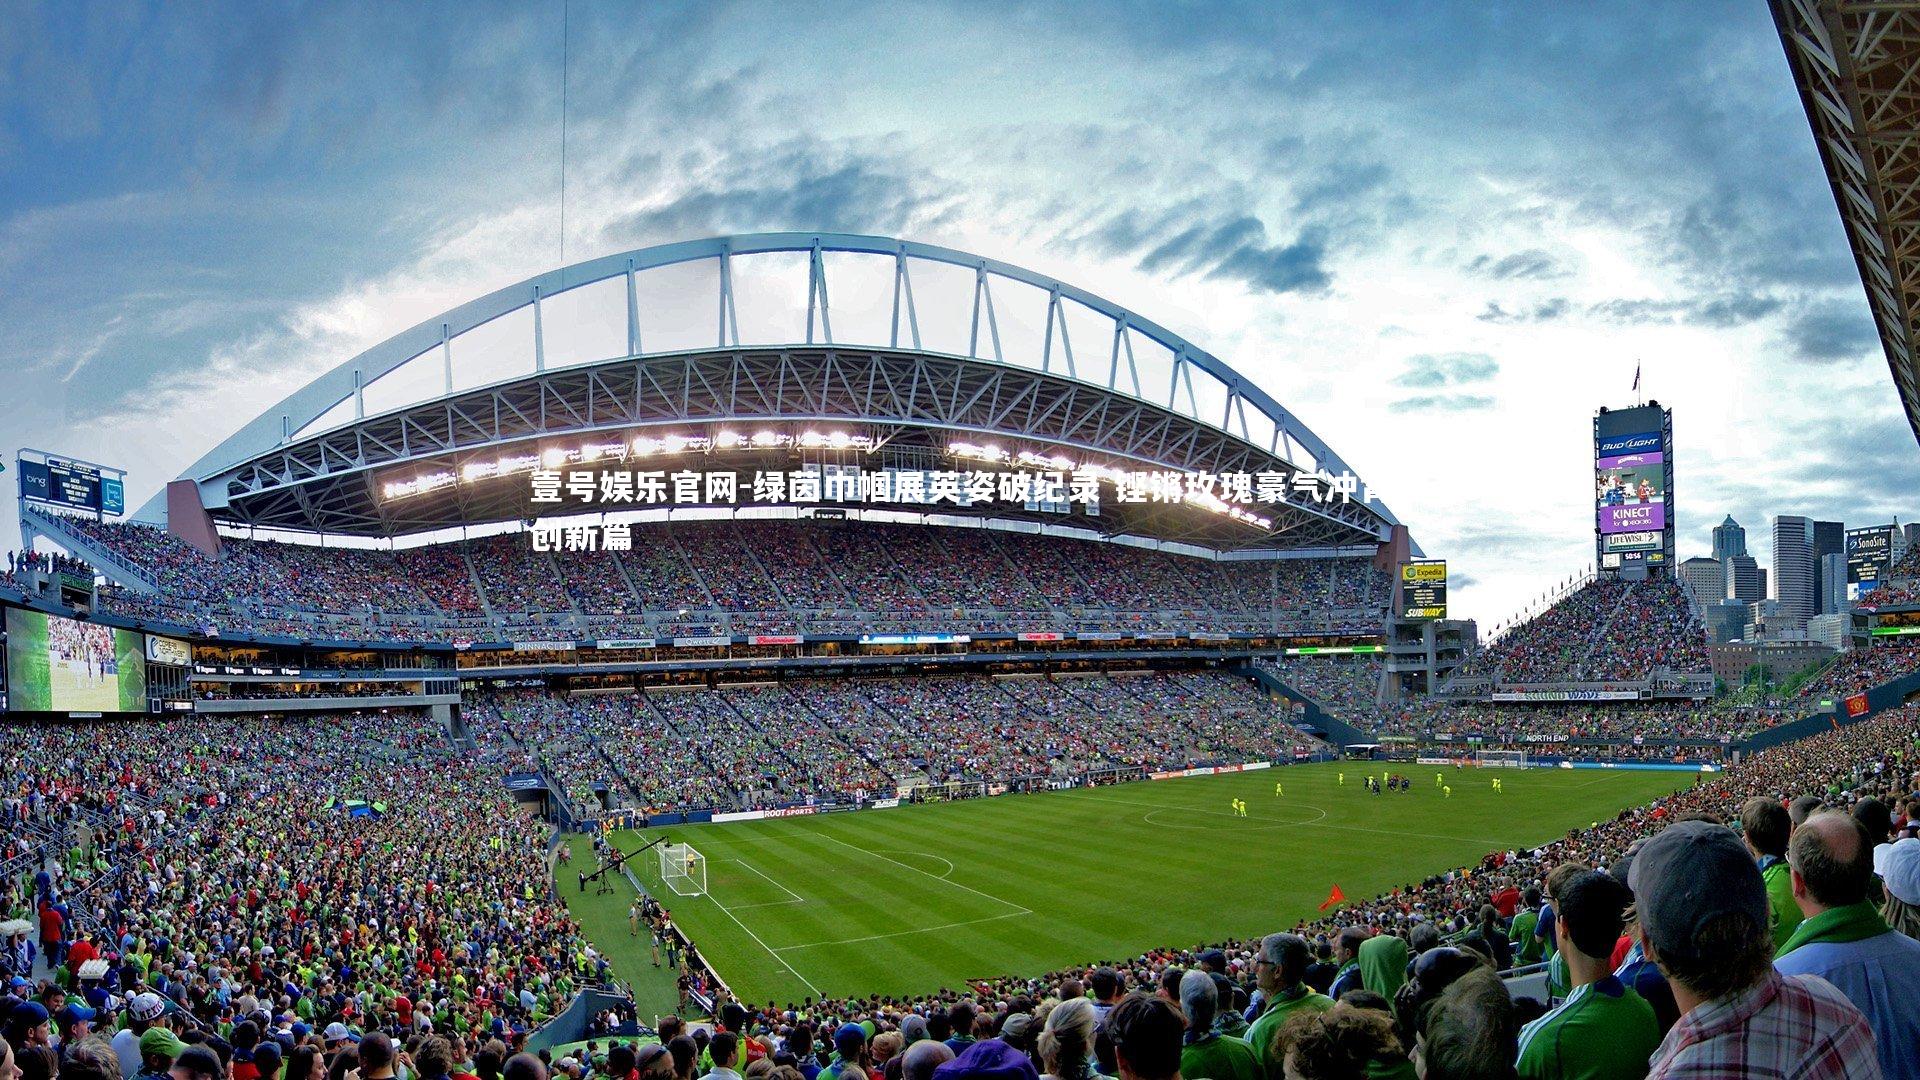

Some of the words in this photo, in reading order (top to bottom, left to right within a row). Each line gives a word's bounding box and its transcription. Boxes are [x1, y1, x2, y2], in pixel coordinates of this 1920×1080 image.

[1601, 442, 1624, 451] BUD
[1628, 438, 1658, 447] LIGHT
[26, 474, 46, 488] bing
[1613, 507, 1652, 519] KINECT
[1858, 536, 1886, 548] SonoSite
[1417, 569, 1442, 577] Expedia
[1405, 608, 1445, 617] SUBWAY
[518, 642, 565, 651] PINNACLE
[611, 640, 651, 648] walottery.com
[685, 638, 710, 646] Qwest
[764, 809, 785, 818] ROOT
